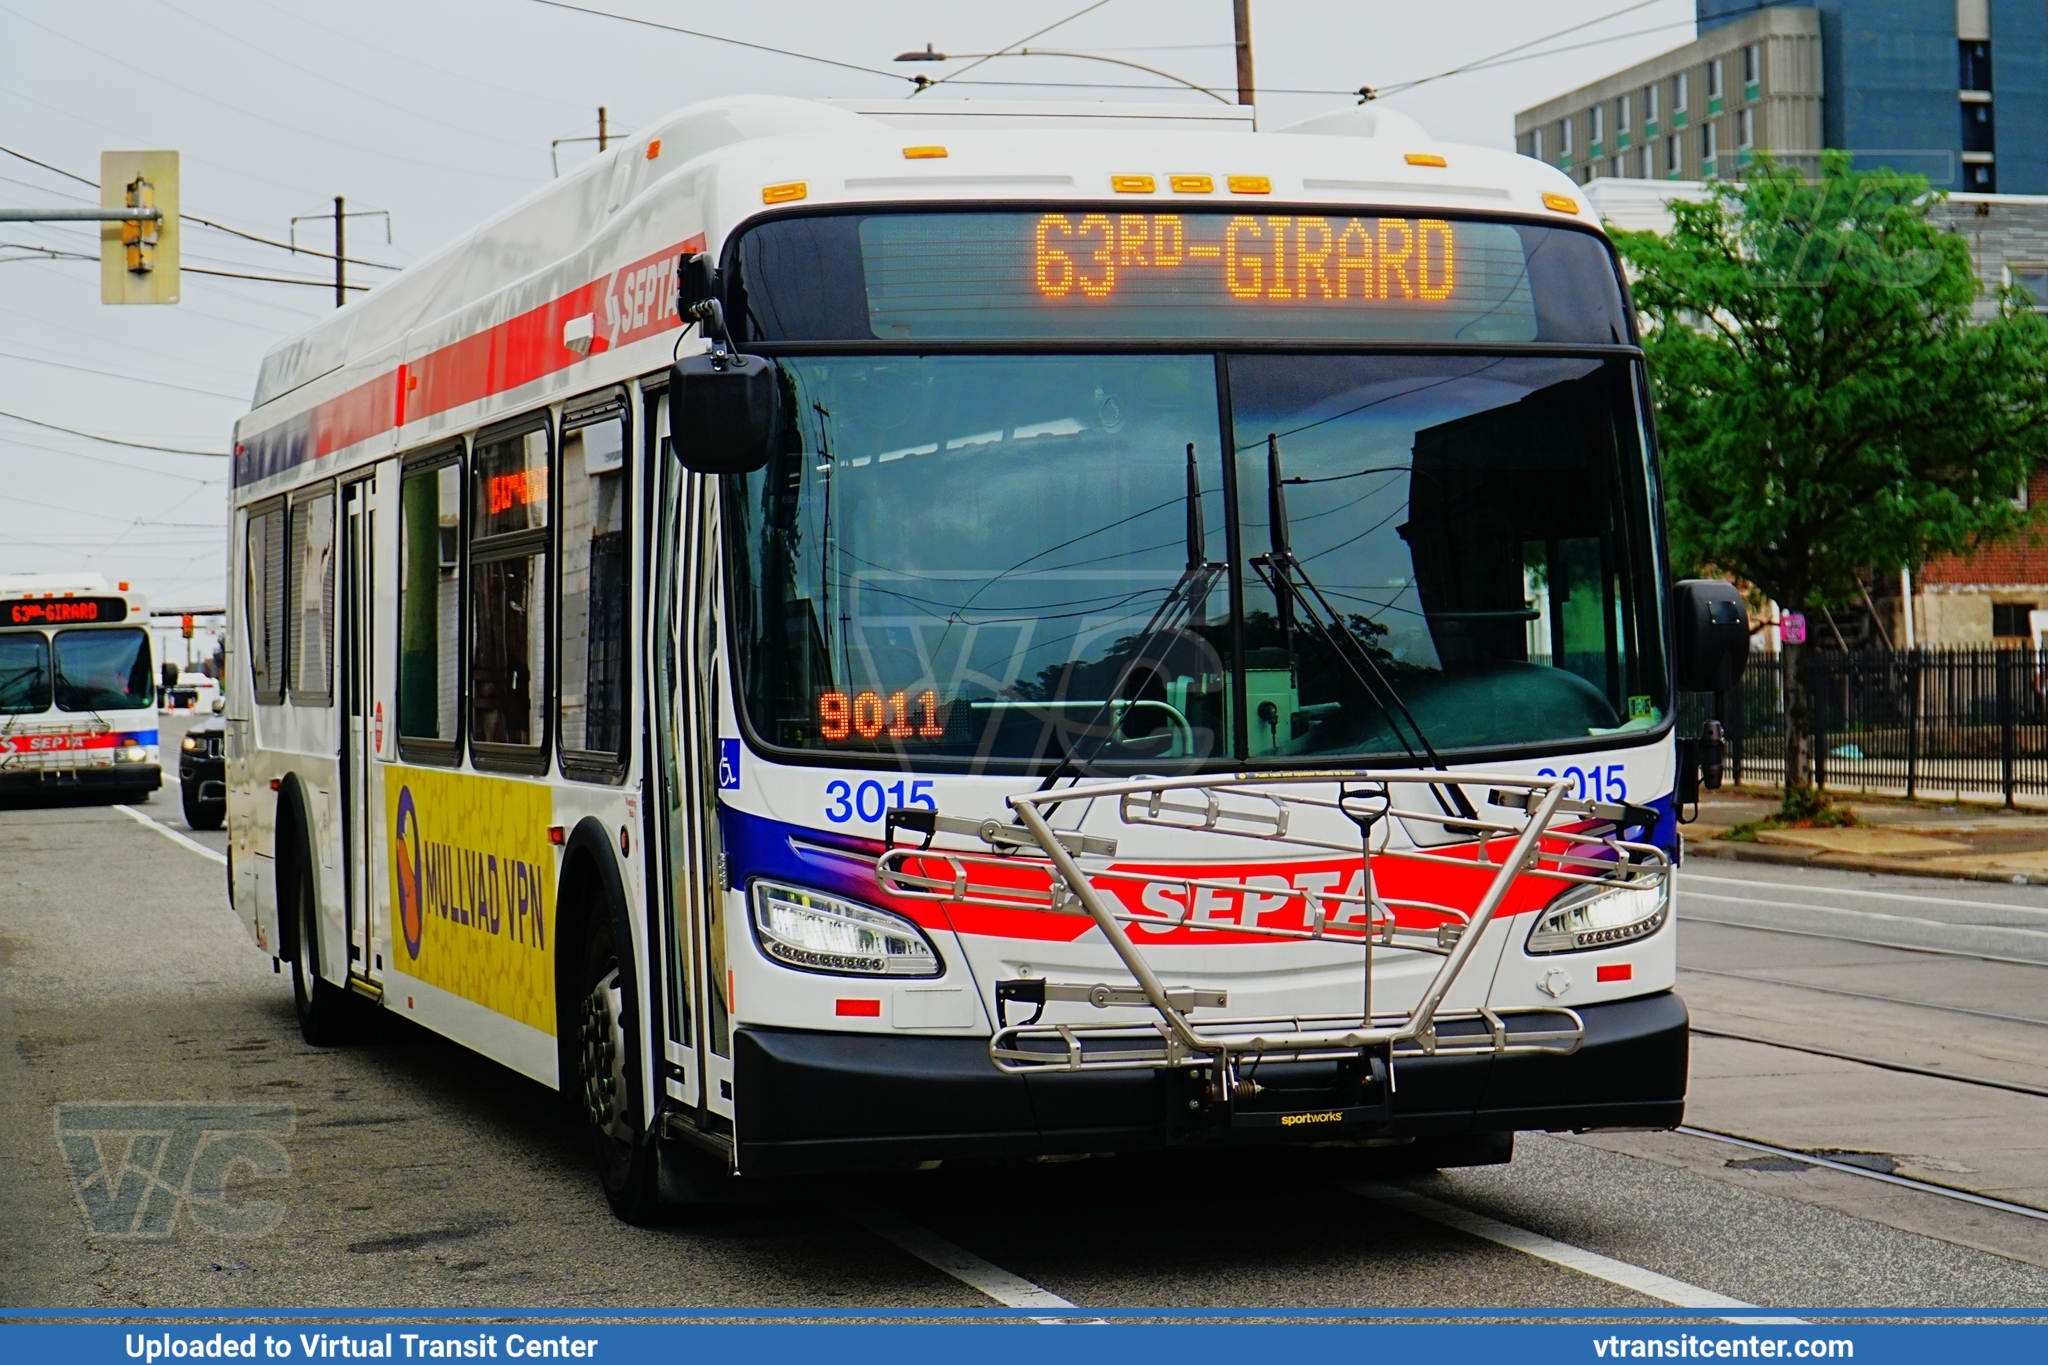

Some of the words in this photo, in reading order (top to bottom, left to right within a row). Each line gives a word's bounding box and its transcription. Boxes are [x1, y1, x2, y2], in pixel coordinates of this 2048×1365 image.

[1036, 214, 1453, 300] 63RD-GIRARD
[621, 255, 679, 333] SEPTA
[820, 691, 943, 738] 9011
[30, 737, 84, 750] SEPTA
[825, 779, 936, 823] 3015
[1537, 764, 1627, 804] 015
[424, 840, 500, 935] MULLVAD
[503, 858, 545, 951] VPN
[1138, 868, 1385, 934] SEPTA
[1281, 1111, 1343, 1126] sportworks
